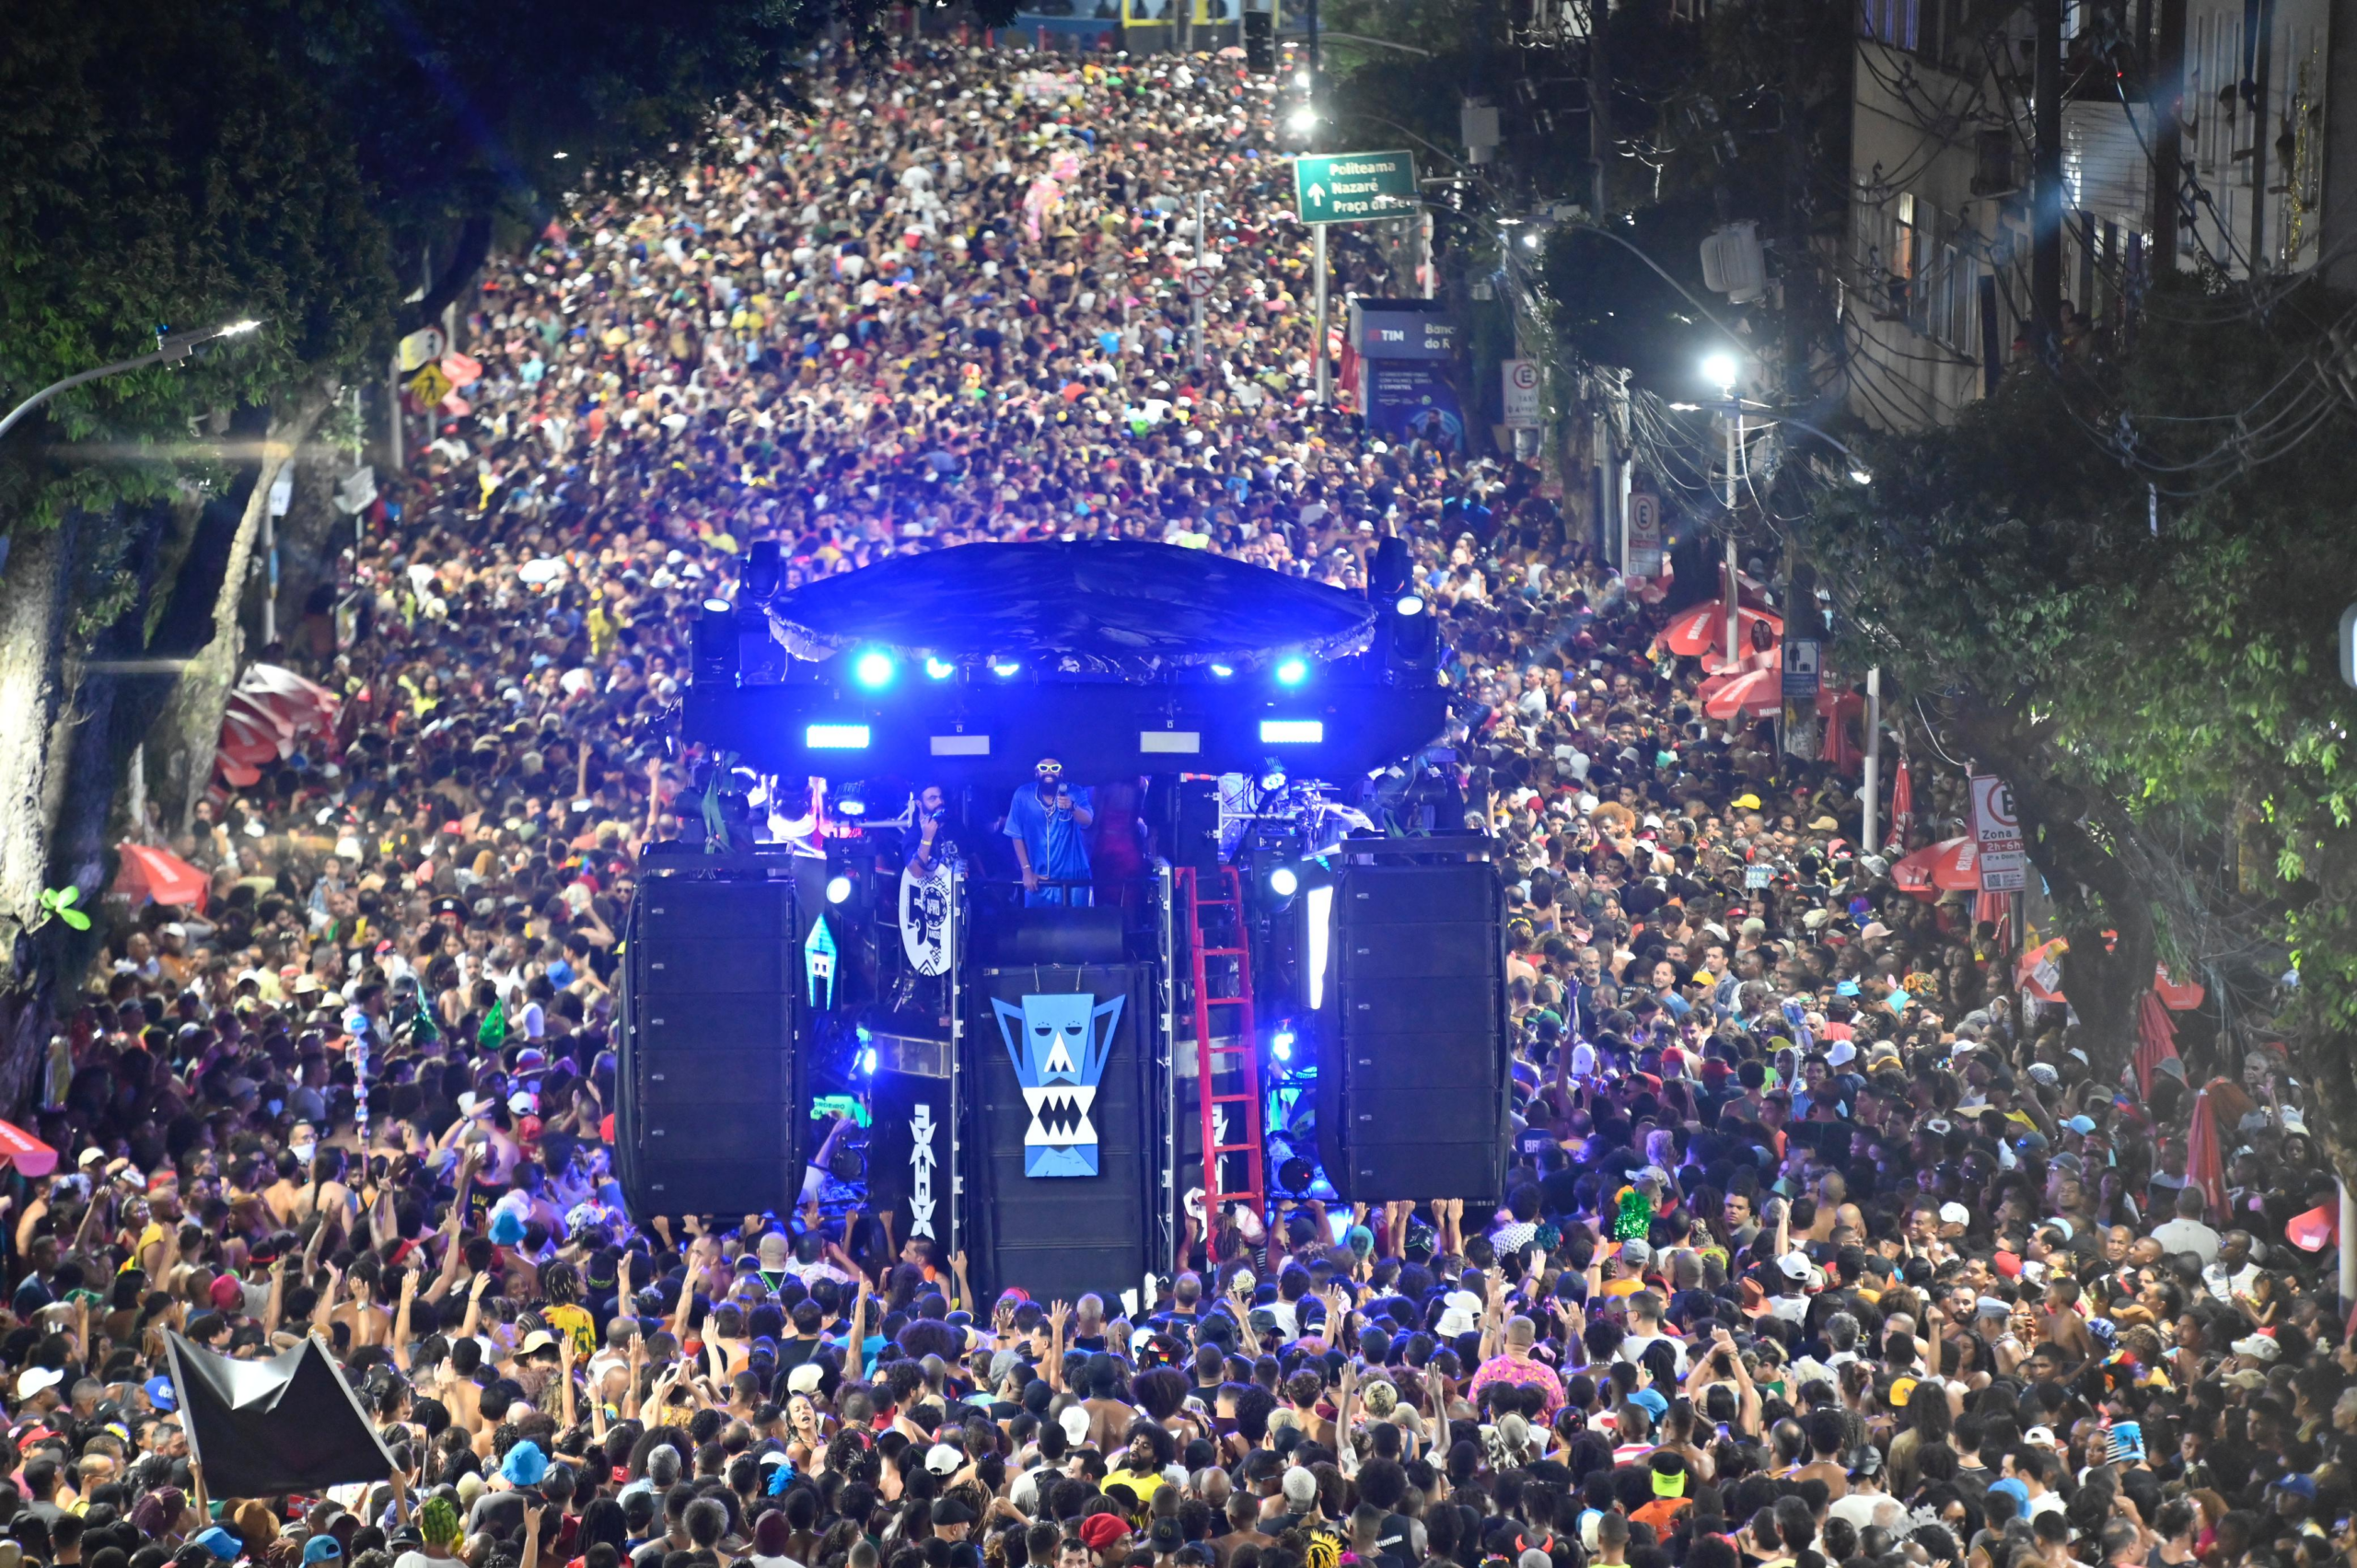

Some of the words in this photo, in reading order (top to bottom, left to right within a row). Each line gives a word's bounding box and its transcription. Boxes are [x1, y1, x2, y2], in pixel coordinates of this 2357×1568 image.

[1329, 162, 1396, 176] Politeama
[1331, 178, 1378, 194] Nazaré
[1333, 201, 1369, 214] Praça
[1381, 330, 1404, 342] TIM
[1424, 338, 1440, 349] do
[1521, 370, 1534, 383] E
[1640, 505, 1648, 524] E
[1759, 706, 1782, 716] BRAHMA
[1981, 830, 2013, 840] Zona
